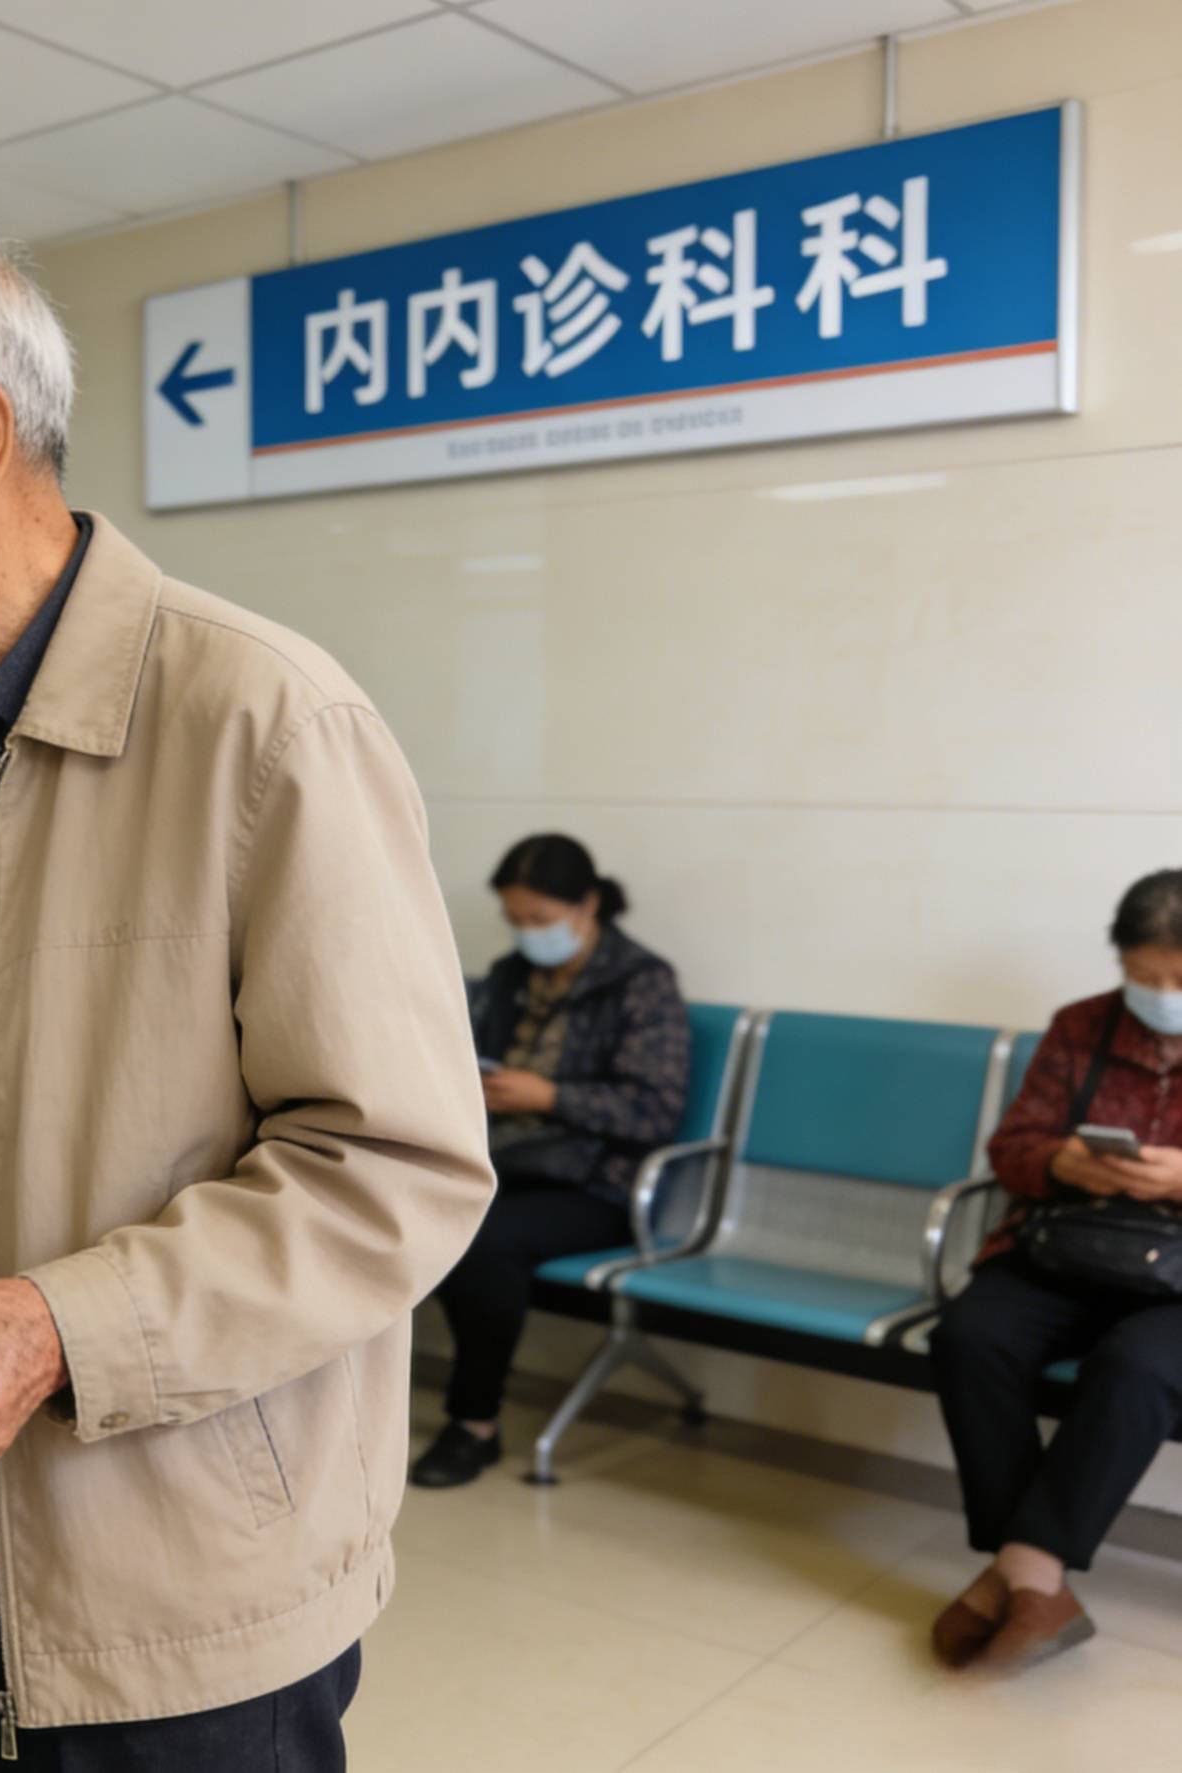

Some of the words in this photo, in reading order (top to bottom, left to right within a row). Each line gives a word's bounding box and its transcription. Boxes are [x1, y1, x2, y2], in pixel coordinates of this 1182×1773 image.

[304, 175, 948, 414] 内内诊科科
